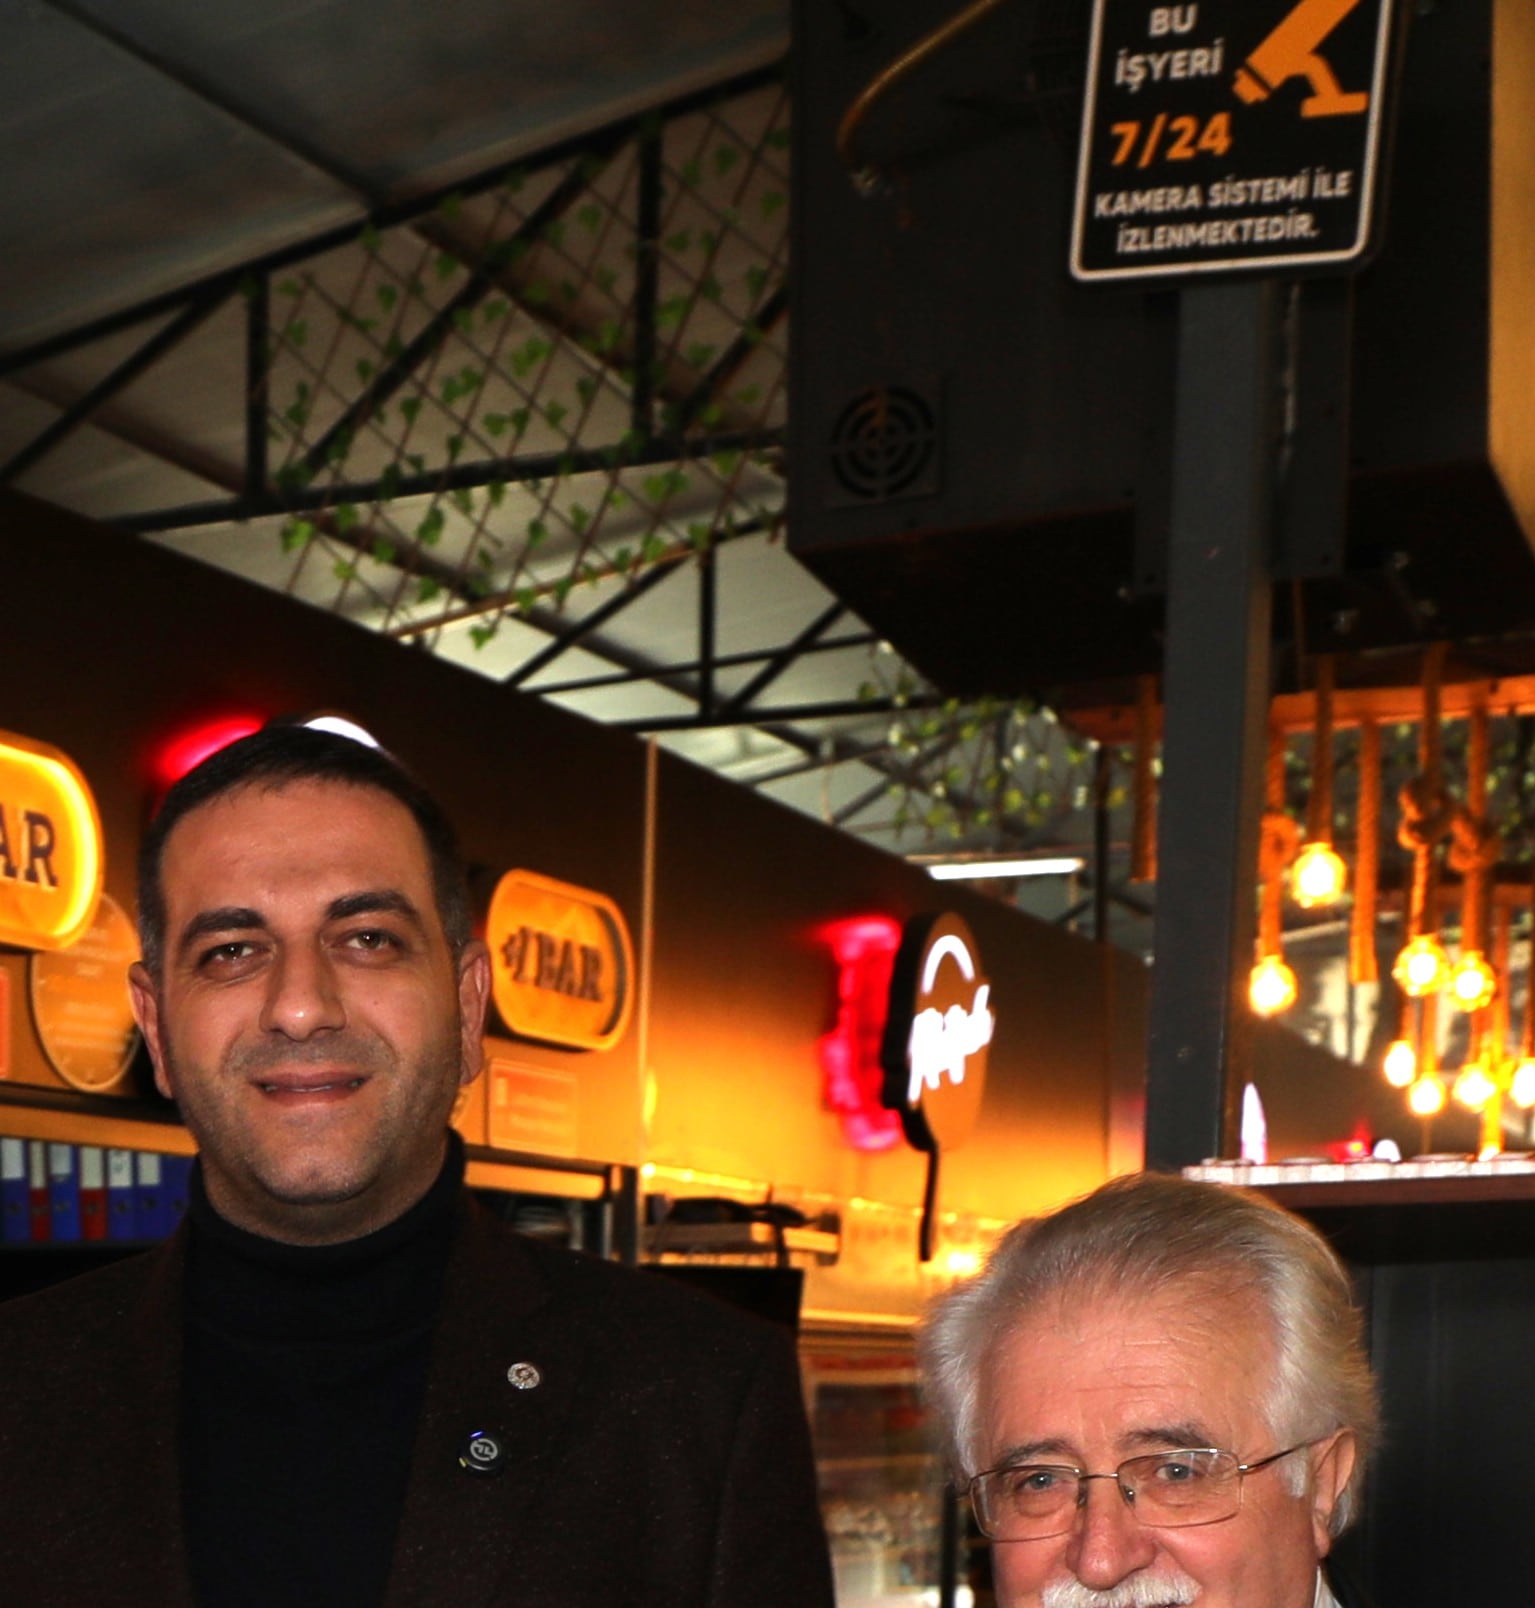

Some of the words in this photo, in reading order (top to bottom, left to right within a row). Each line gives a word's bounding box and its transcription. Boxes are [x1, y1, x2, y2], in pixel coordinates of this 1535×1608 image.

[1149, 4, 1198, 36] BU
[1114, 39, 1224, 92] İŞYERİ
[1110, 112, 1233, 169] 7/24
[1094, 184, 1202, 218] KAMERA
[1208, 168, 1309, 207] SİSTEMİ
[1313, 165, 1353, 197] İLE
[1116, 208, 1319, 253] İZLENMEKTEDİR.
